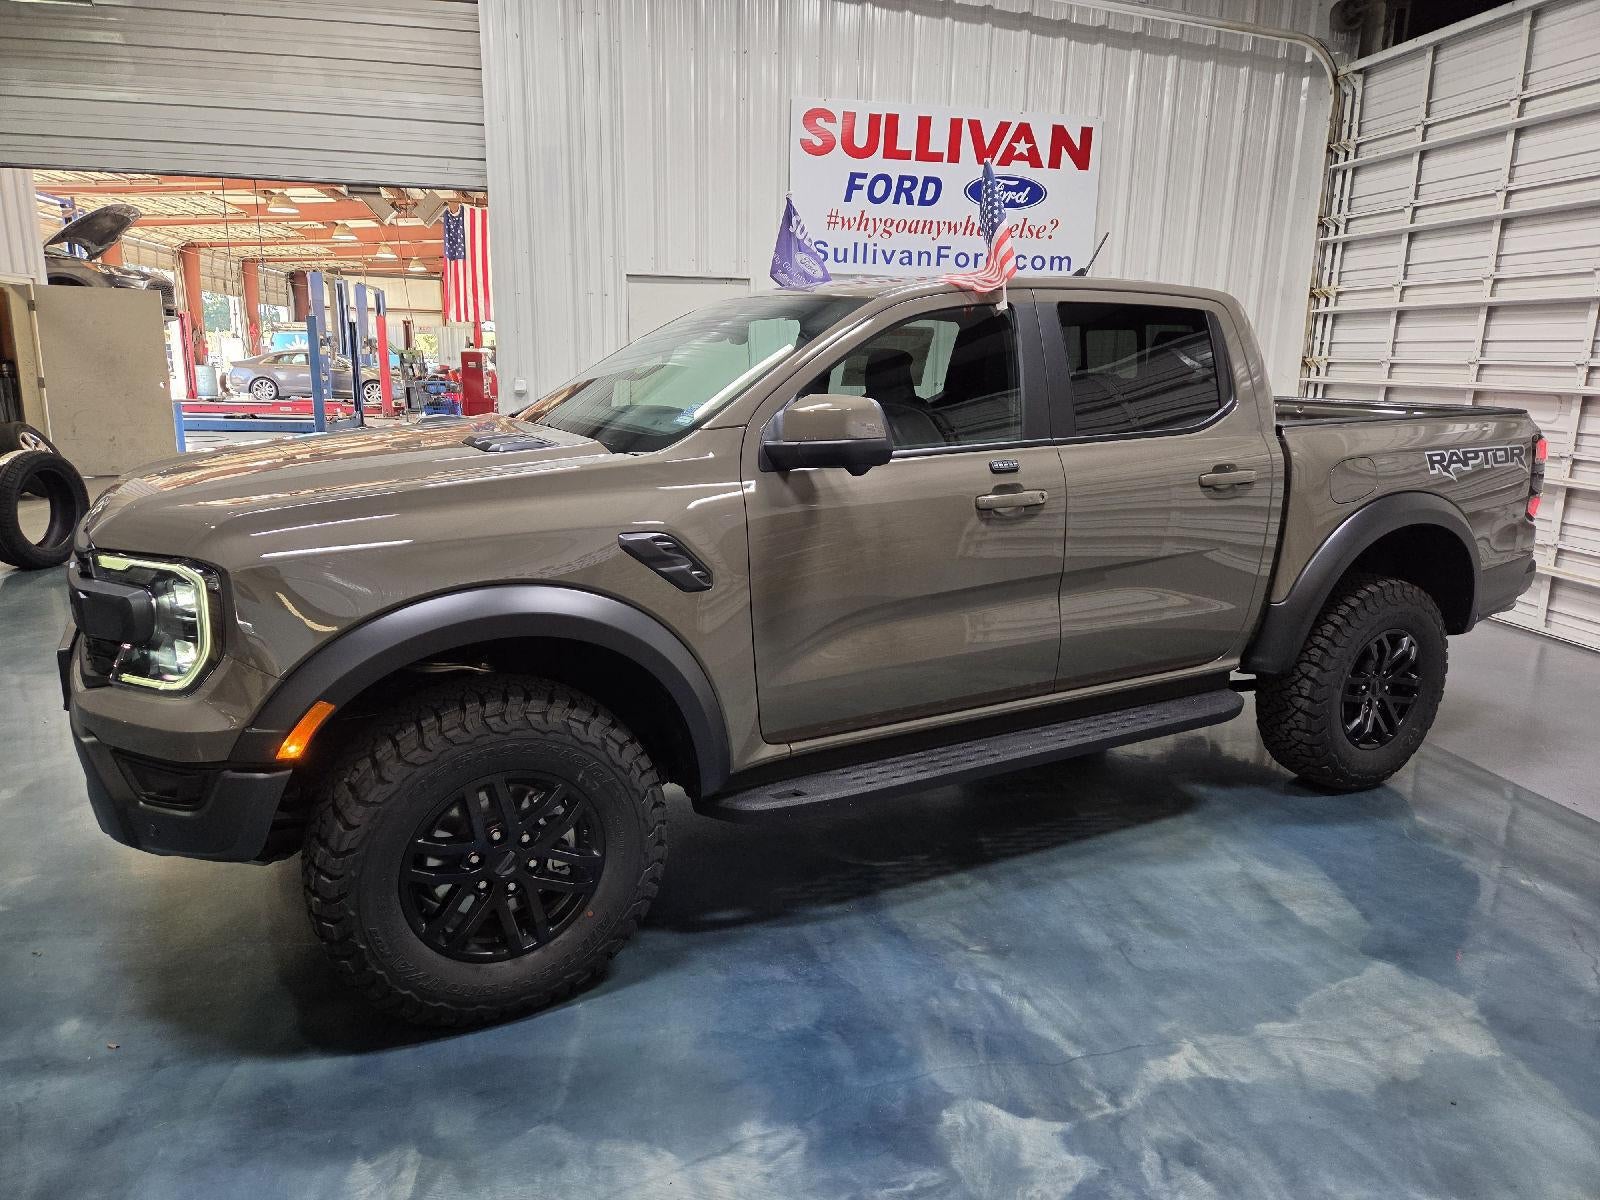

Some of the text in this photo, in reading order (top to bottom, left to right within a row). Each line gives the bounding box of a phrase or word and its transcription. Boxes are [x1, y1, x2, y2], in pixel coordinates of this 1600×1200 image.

[799, 107, 1094, 171] SULLIVAN
[843, 171, 943, 207] FORD
[826, 208, 1060, 241] #whygoanywheelse?
[813, 240, 1072, 272] SullivanForcom
[1424, 444, 1529, 482] RAPTOR
